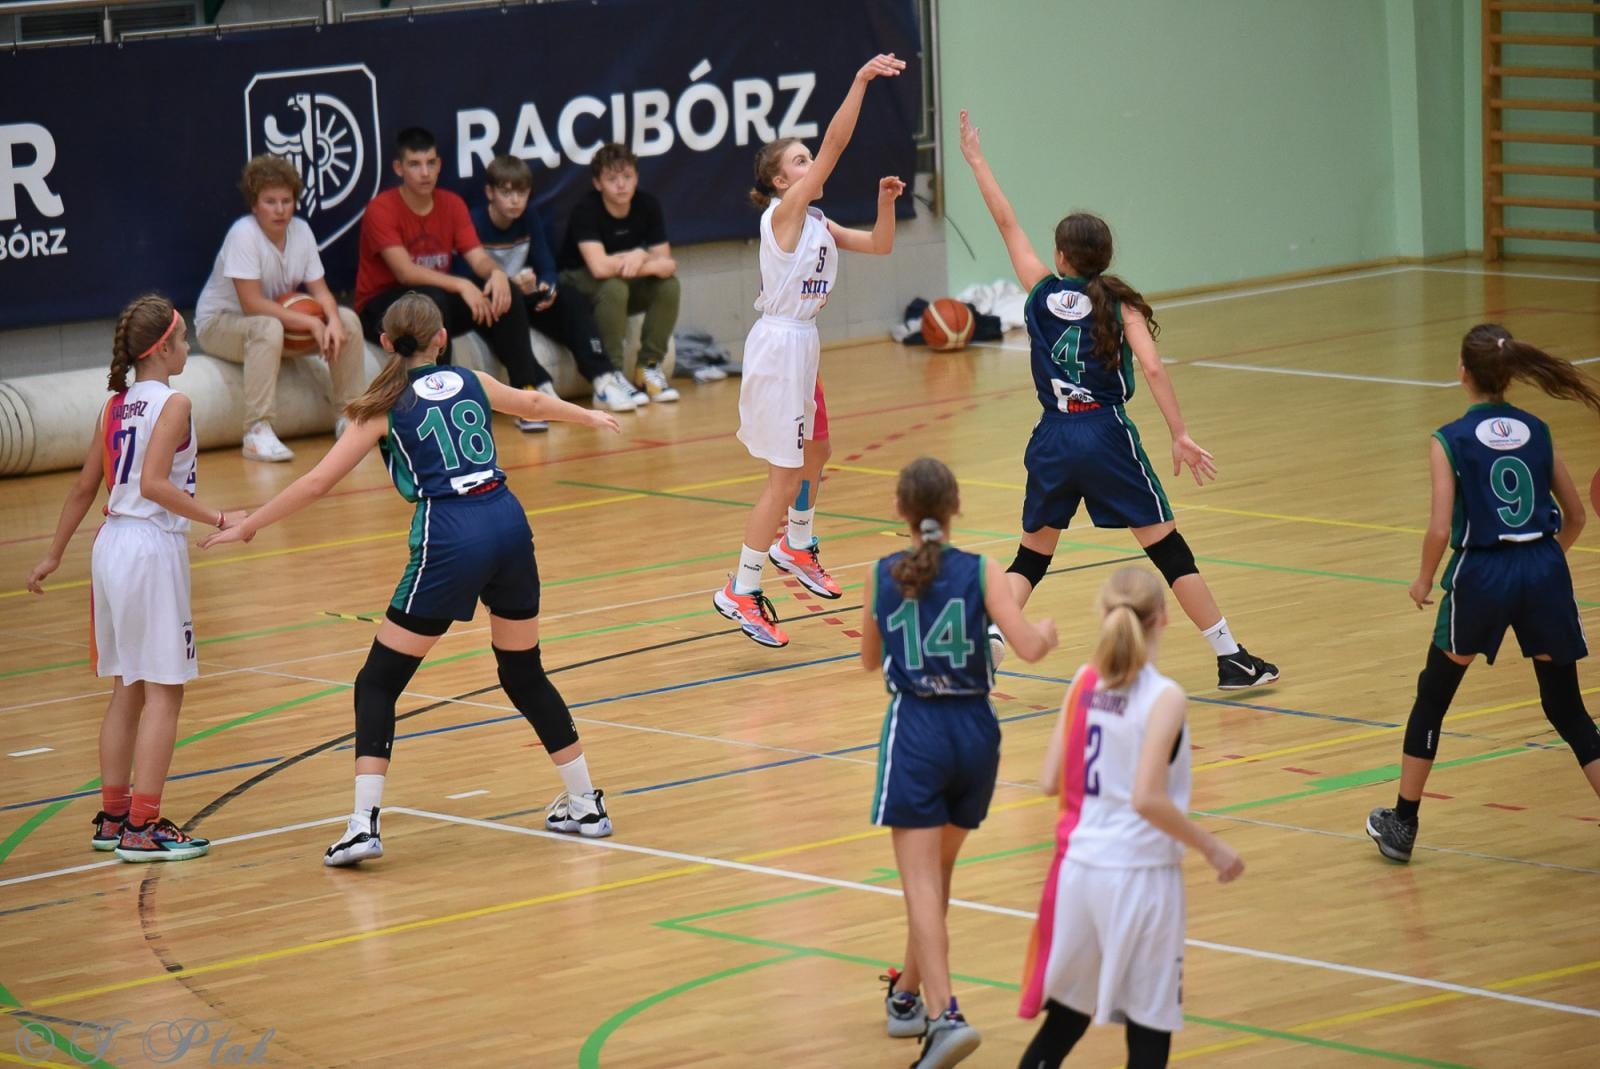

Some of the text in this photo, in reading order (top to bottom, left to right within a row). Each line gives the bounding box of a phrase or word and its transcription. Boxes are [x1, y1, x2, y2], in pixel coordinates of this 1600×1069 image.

[456, 58, 819, 178] RACIBÓRZ
[0, 122, 65, 221] R
[1050, 325, 1086, 385] 4
[416, 399, 495, 471] 18
[1489, 455, 1535, 528] 9
[886, 597, 976, 671] 14
[1085, 724, 1102, 796] 2
